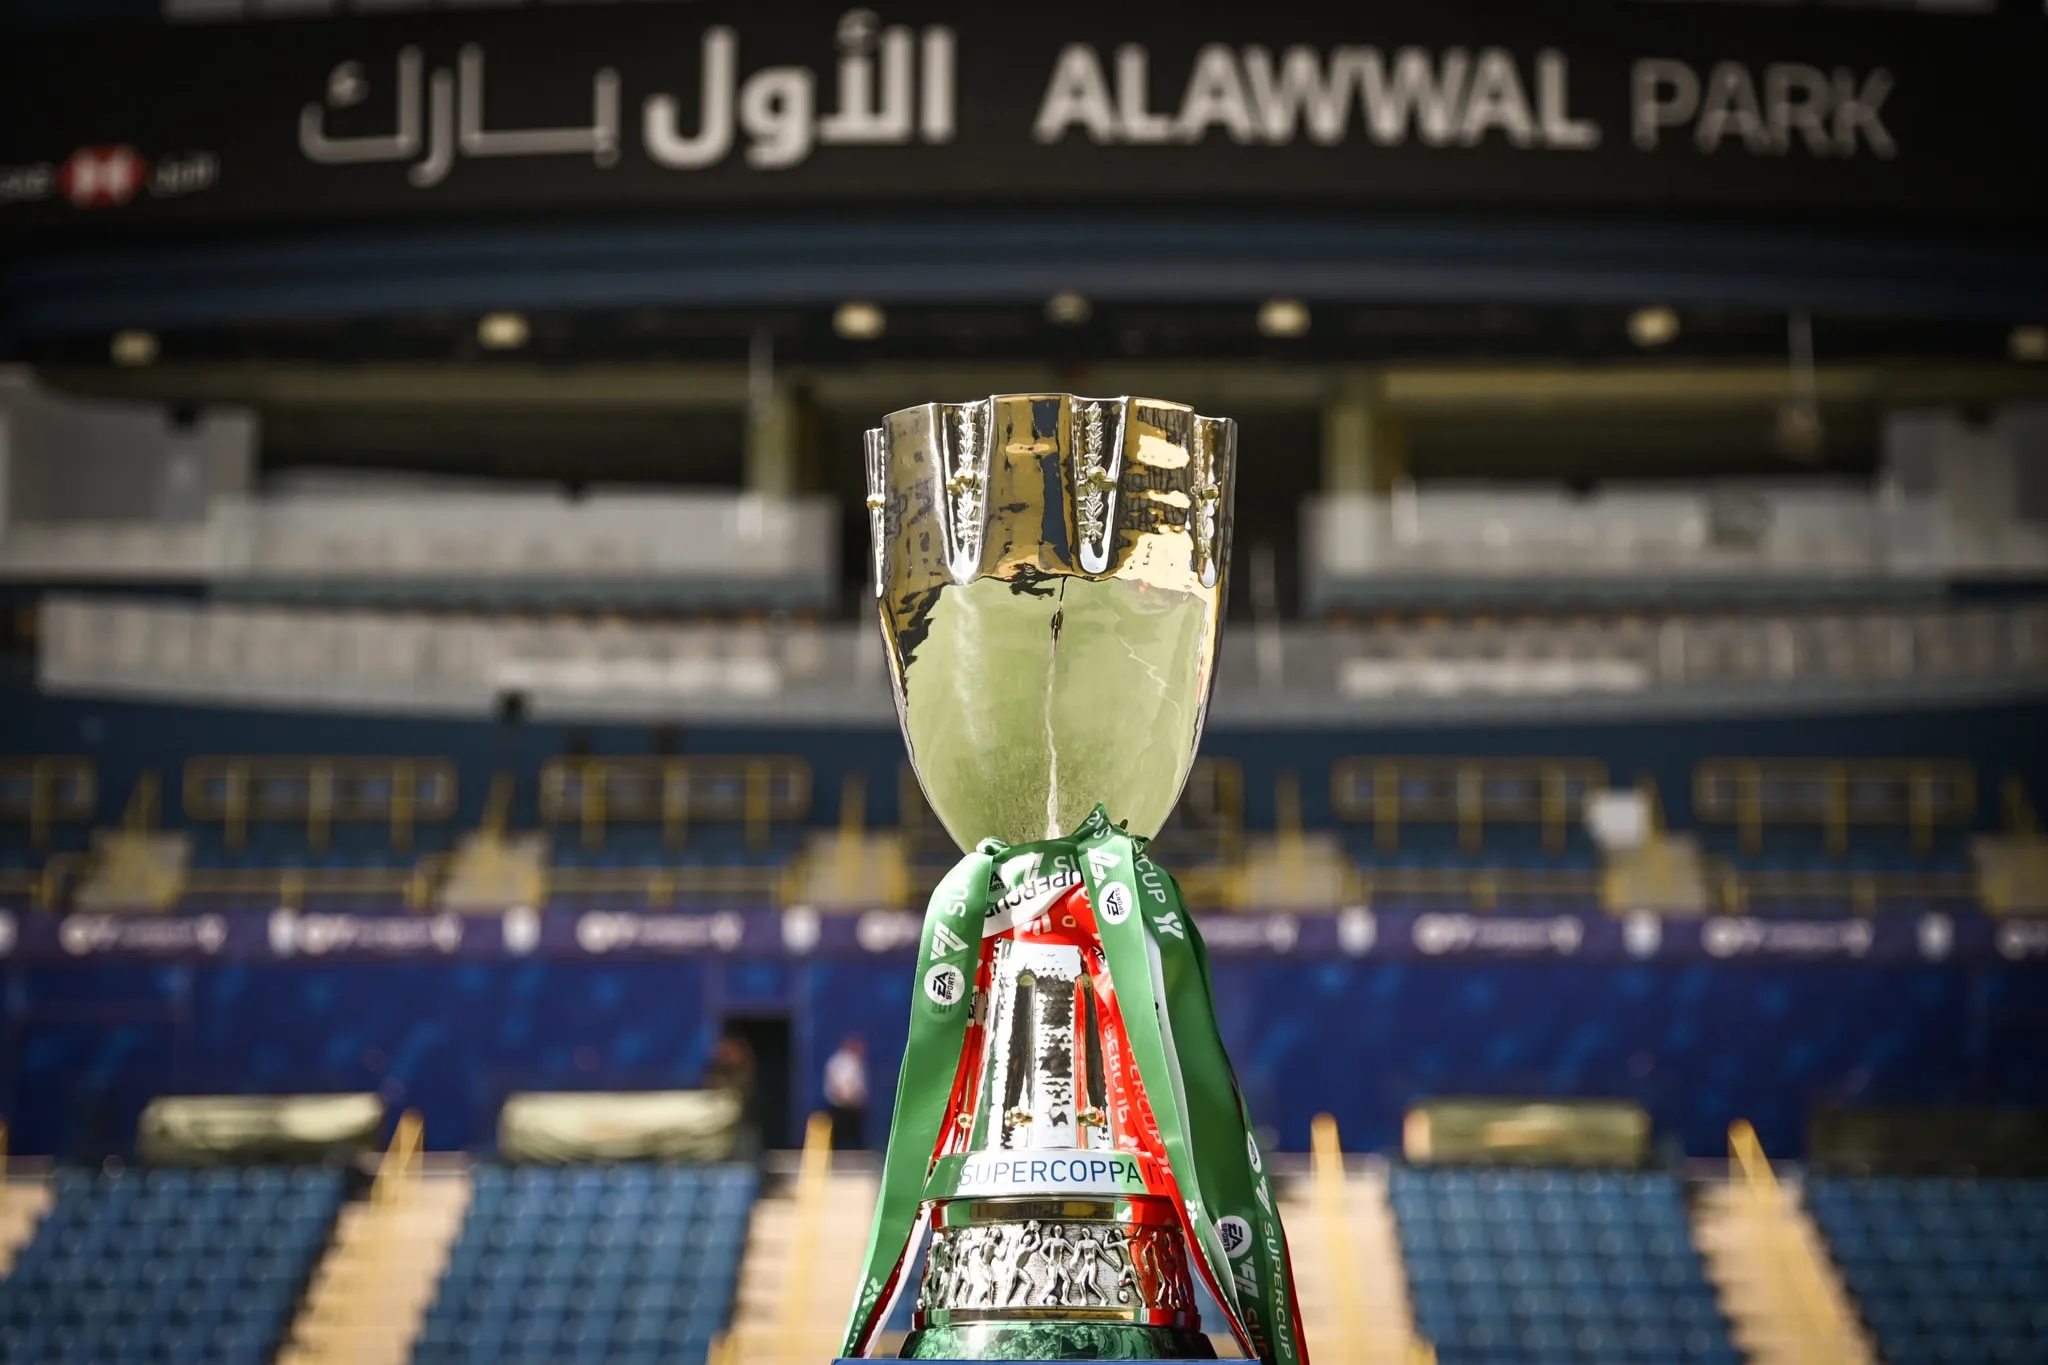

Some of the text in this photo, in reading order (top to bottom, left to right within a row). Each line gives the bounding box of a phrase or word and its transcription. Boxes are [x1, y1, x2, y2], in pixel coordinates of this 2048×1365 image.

[643, 9, 955, 168] الأول
[1031, 43, 1898, 158] ALAWWAL PARK
[933, 971, 949, 998] EA
[945, 971, 956, 1000] SPORTS
[960, 1160, 1143, 1186] SUPERCOPPA
[1220, 1223, 1230, 1252] SPORTS
[1227, 1223, 1243, 1250] EA
[1264, 1222, 1292, 1359] SUPERCUP
